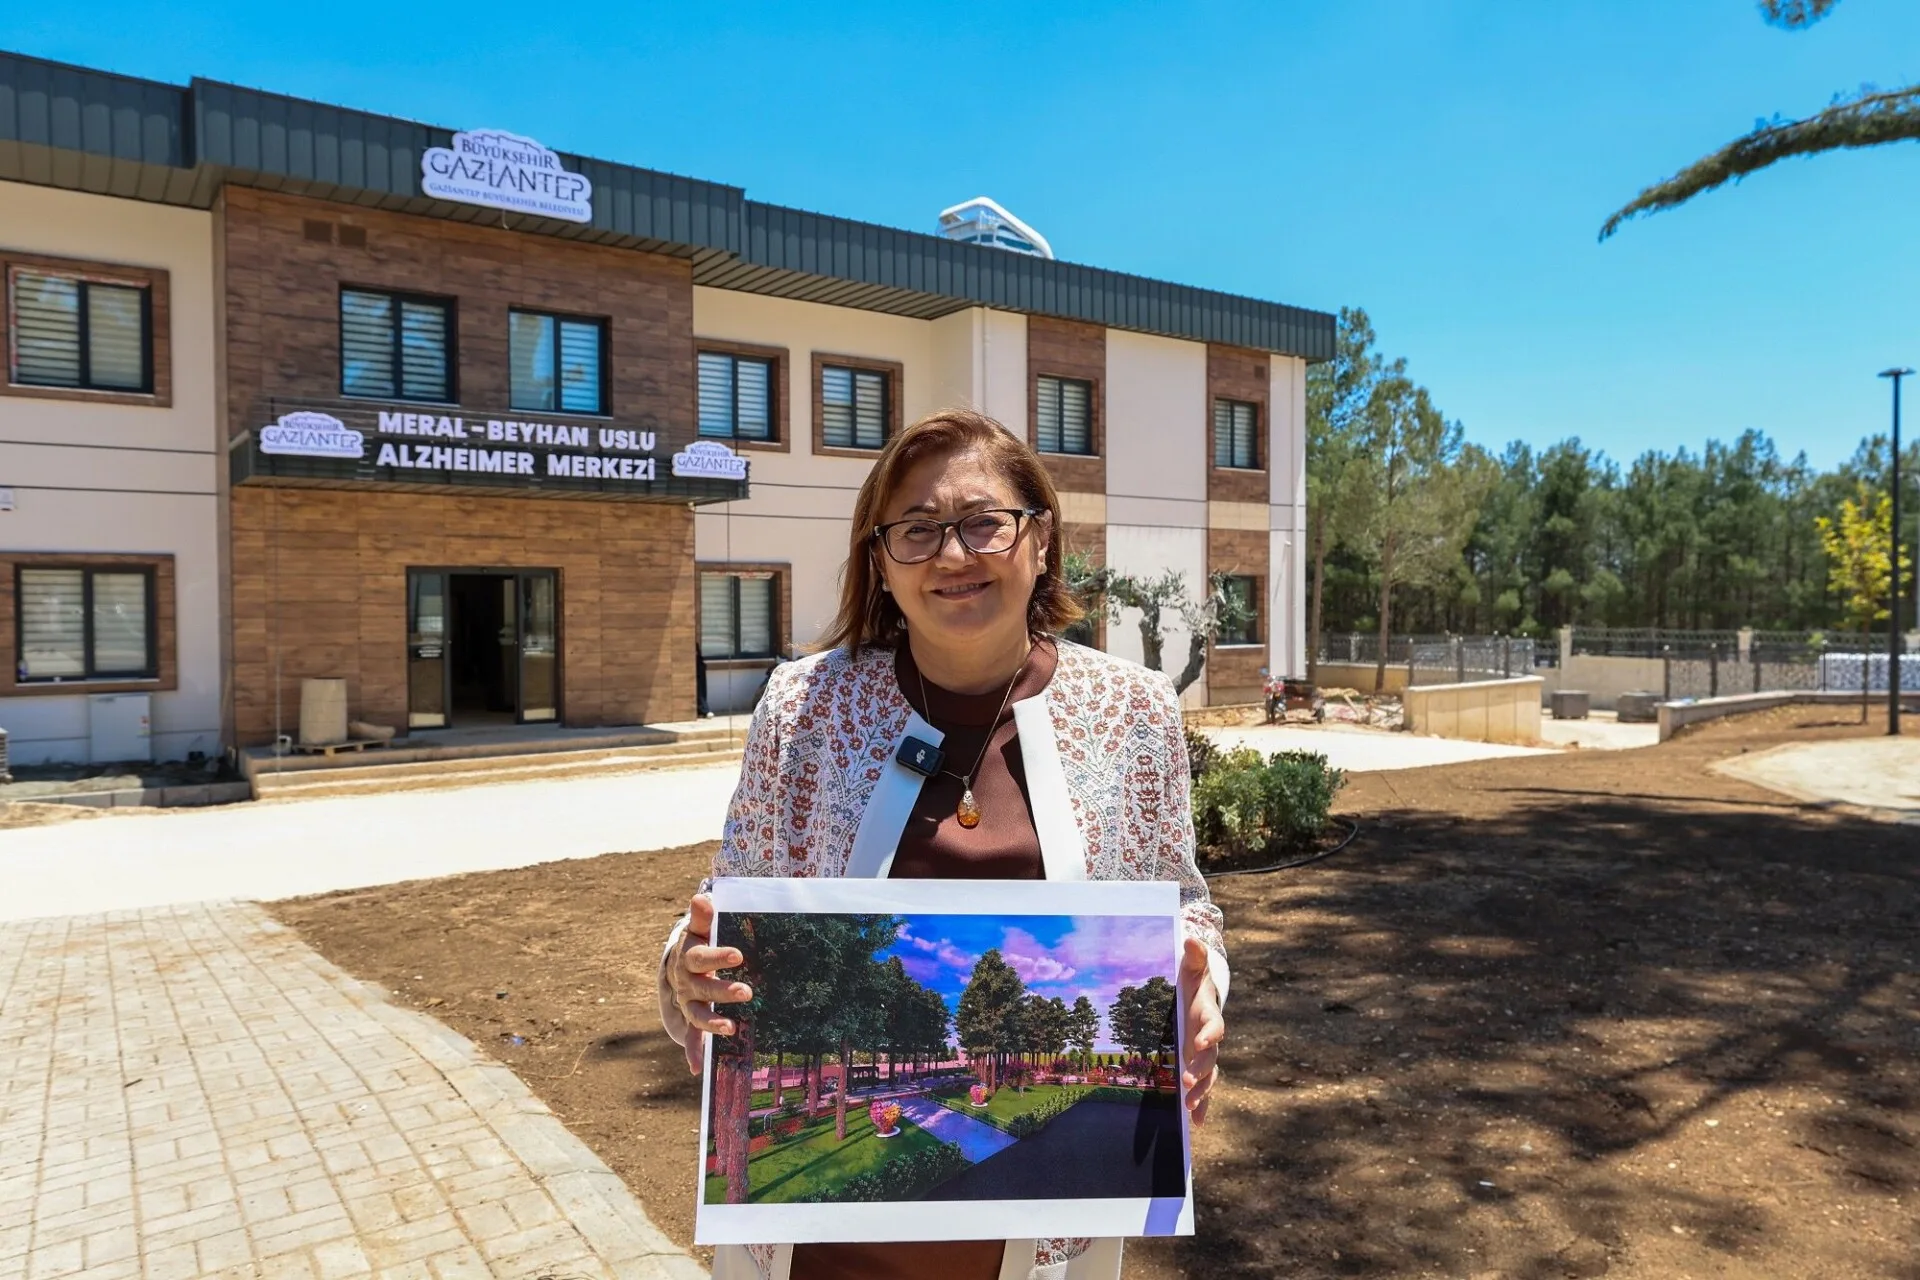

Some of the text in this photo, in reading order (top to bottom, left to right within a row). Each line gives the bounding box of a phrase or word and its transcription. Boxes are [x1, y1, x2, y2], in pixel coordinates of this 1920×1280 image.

[461, 138, 555, 169] BÜYÜKŞEHİR
[599, 429, 656, 451] USLU
[376, 443, 656, 481] ALZHEIMER MERKEZİ
